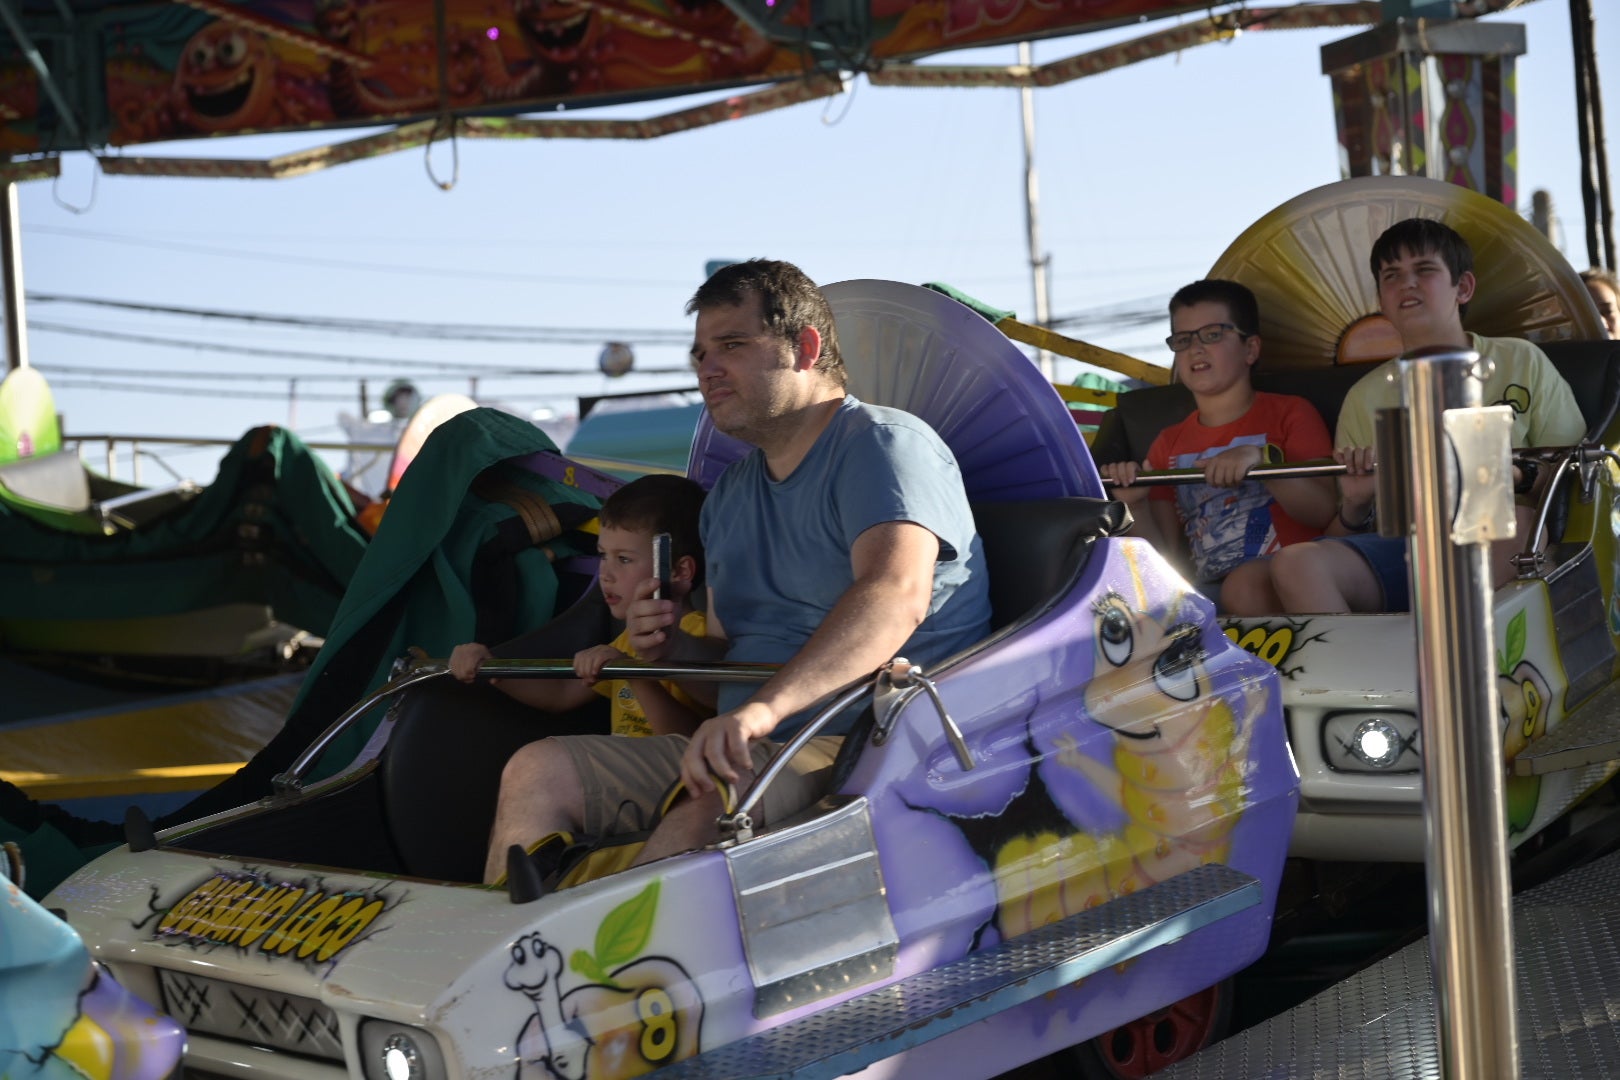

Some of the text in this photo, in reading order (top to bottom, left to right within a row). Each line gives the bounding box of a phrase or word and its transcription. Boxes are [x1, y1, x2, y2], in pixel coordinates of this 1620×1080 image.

[1521, 679, 1541, 738] 9
[158, 876, 385, 962] GUSANO LOCO
[637, 987, 677, 1062] 8
